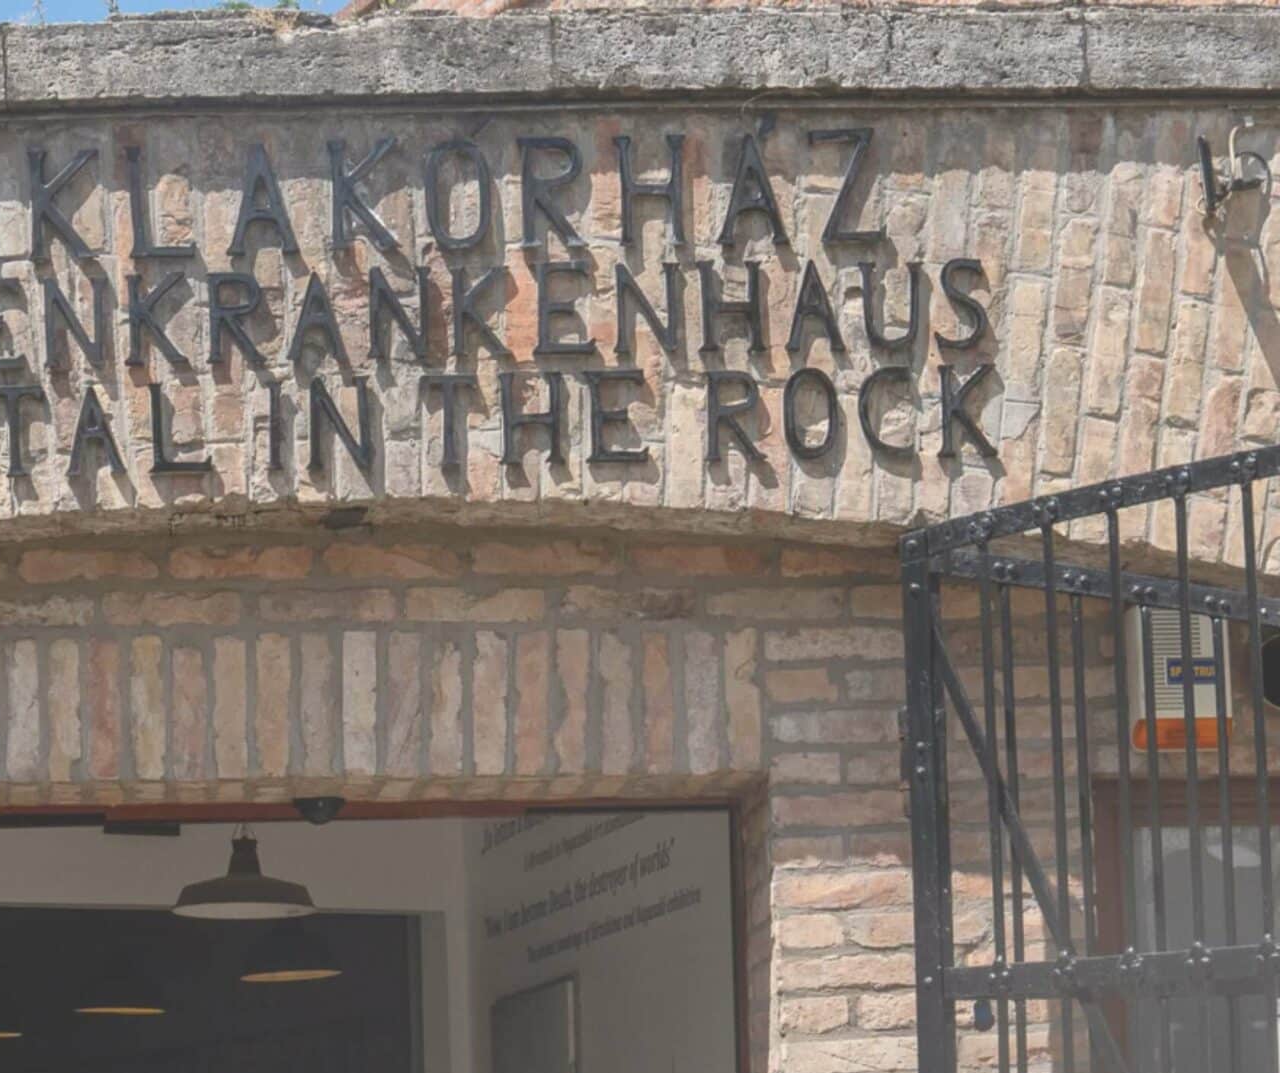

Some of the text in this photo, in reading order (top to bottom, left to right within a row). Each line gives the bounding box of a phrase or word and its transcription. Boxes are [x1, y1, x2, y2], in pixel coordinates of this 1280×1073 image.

[268, 374, 373, 474] IN
[419, 368, 650, 475] THE
[705, 364, 999, 462] ROCK
